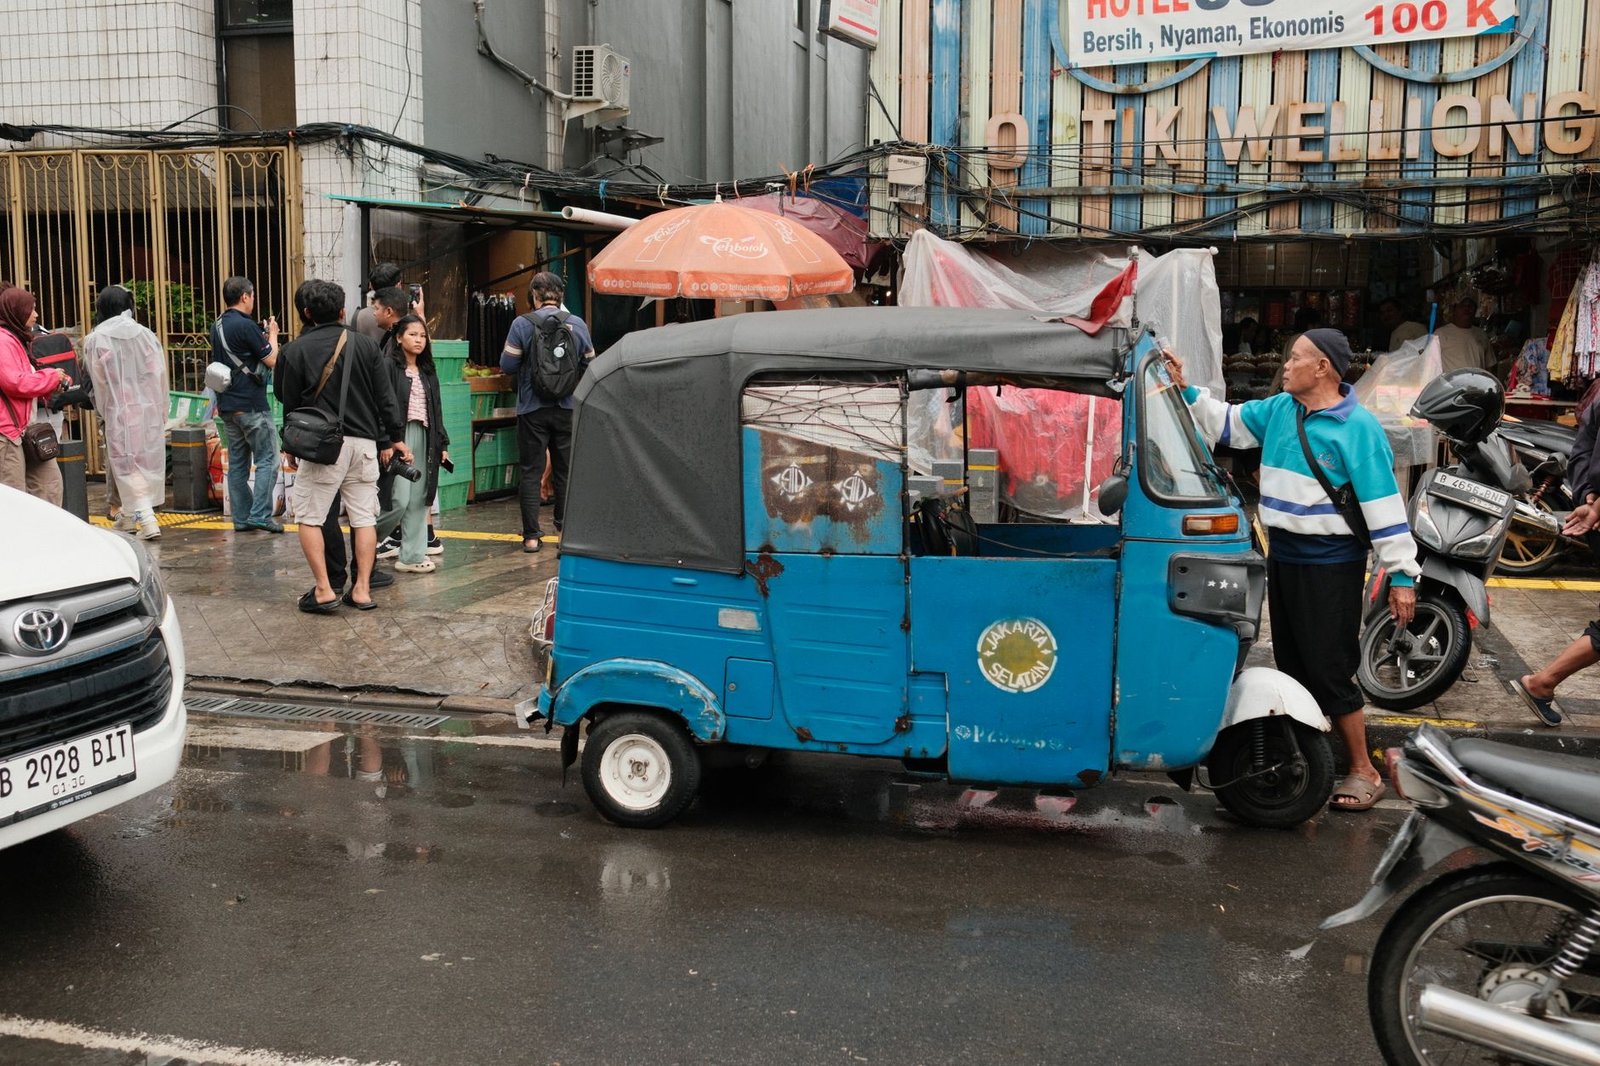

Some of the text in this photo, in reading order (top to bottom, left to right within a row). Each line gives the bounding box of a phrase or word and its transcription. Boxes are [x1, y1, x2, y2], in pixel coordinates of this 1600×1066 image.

[1083, 27, 1142, 54] Bersih
[1160, 24, 1243, 51] Nyaman,
[1250, 10, 1345, 40] Ekonomis
[1365, 0, 1501, 36] 100 K
[1211, 91, 1597, 166] WELLIONG
[986, 619, 1049, 650] JAKARTA
[988, 660, 1050, 689] SELATAN
[0, 729, 128, 798] B 2928 BIT
